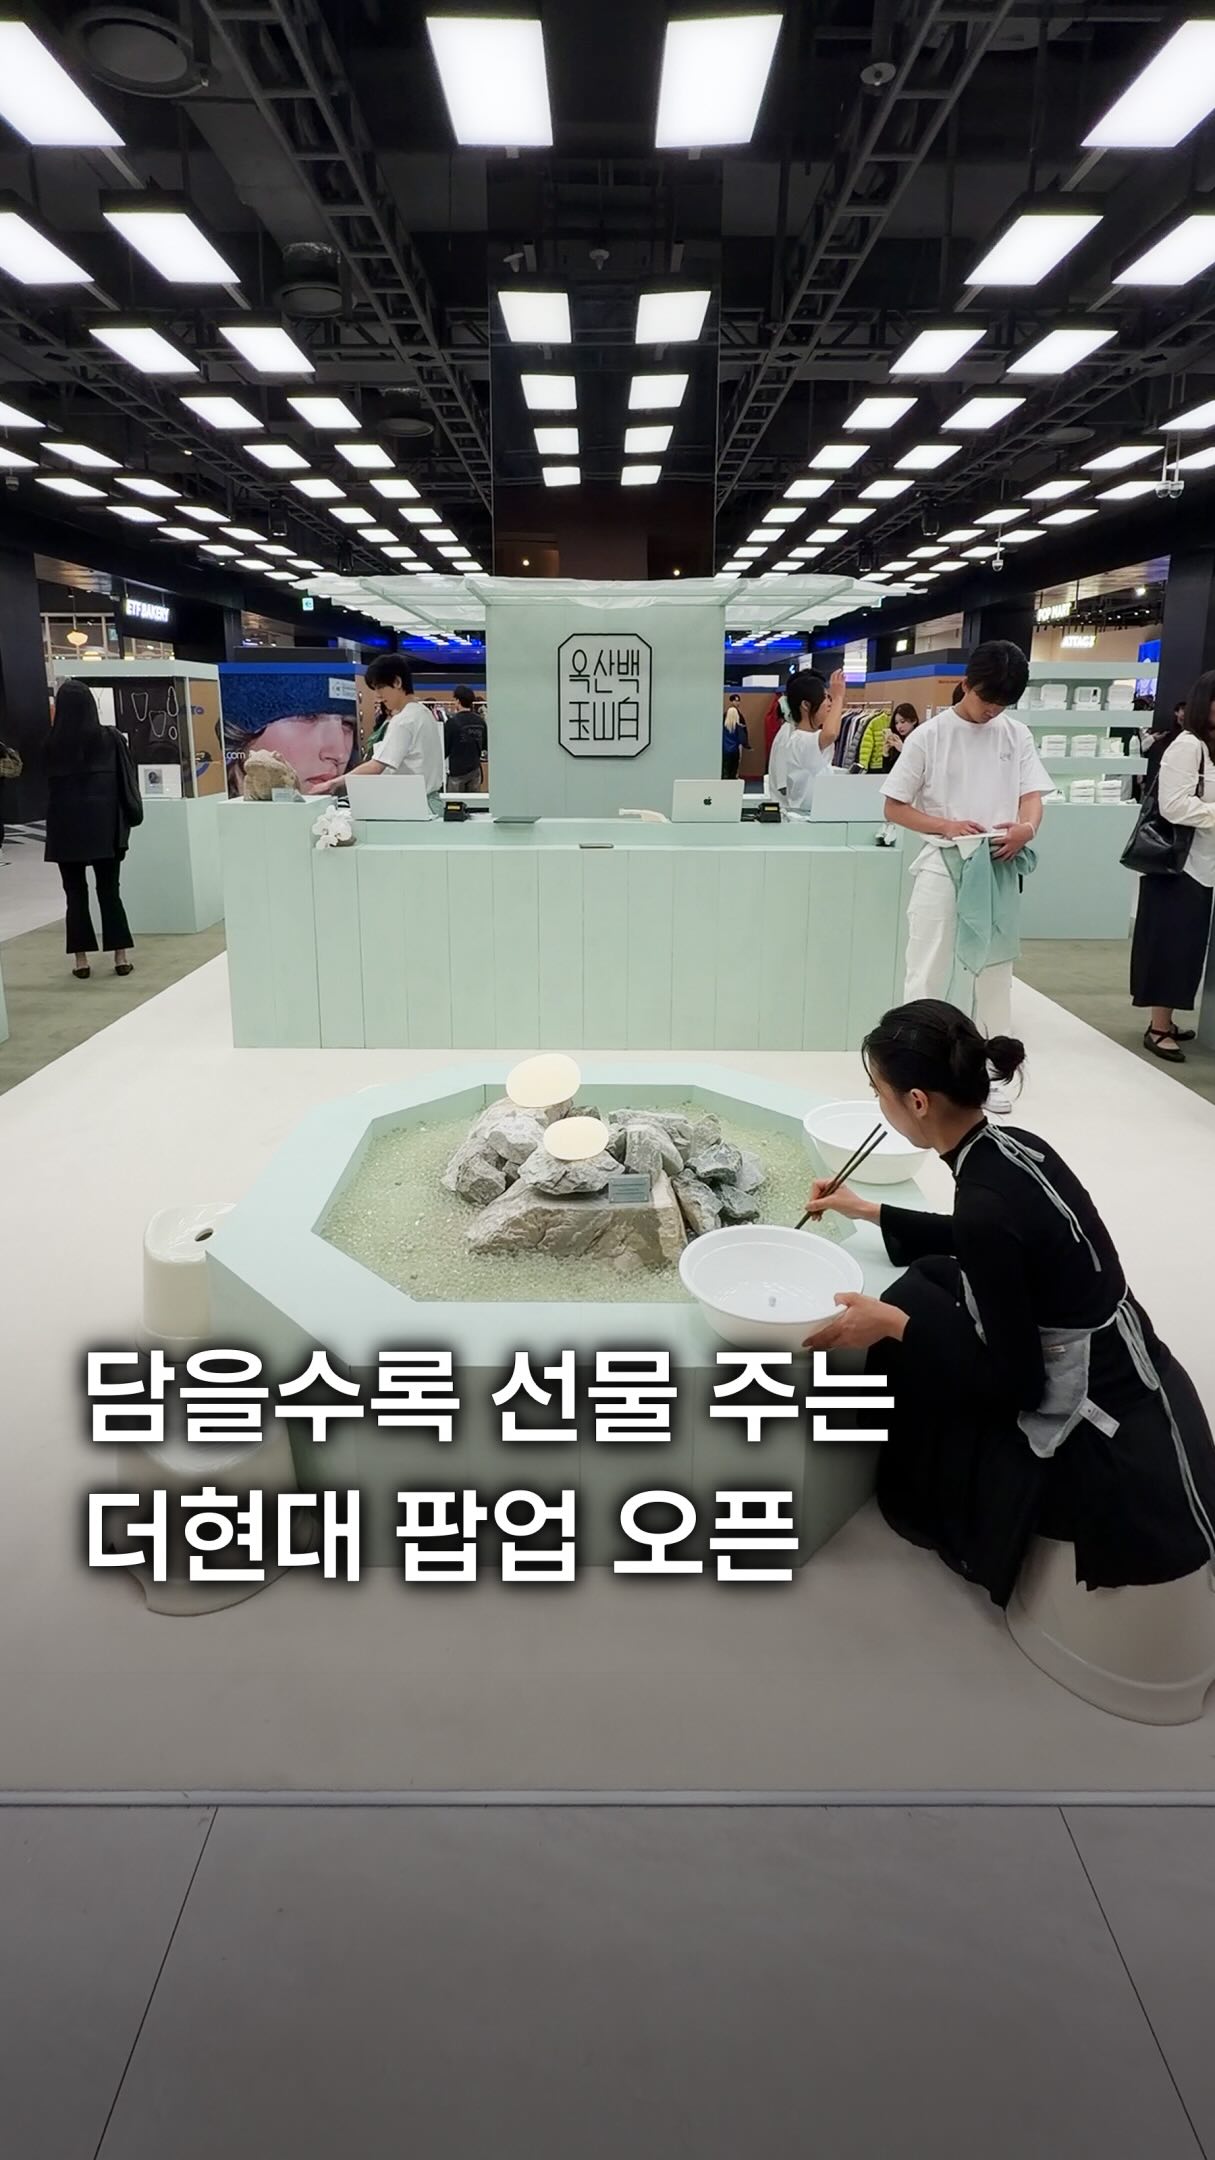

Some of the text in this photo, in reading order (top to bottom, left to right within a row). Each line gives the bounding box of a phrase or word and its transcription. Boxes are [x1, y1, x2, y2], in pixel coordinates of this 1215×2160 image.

[126, 599, 170, 622] ETF BAKERY
[1037, 602, 1072, 622] POP MART
[569, 649, 640, 694] 옥산백
[568, 696, 640, 741] 玉山白
